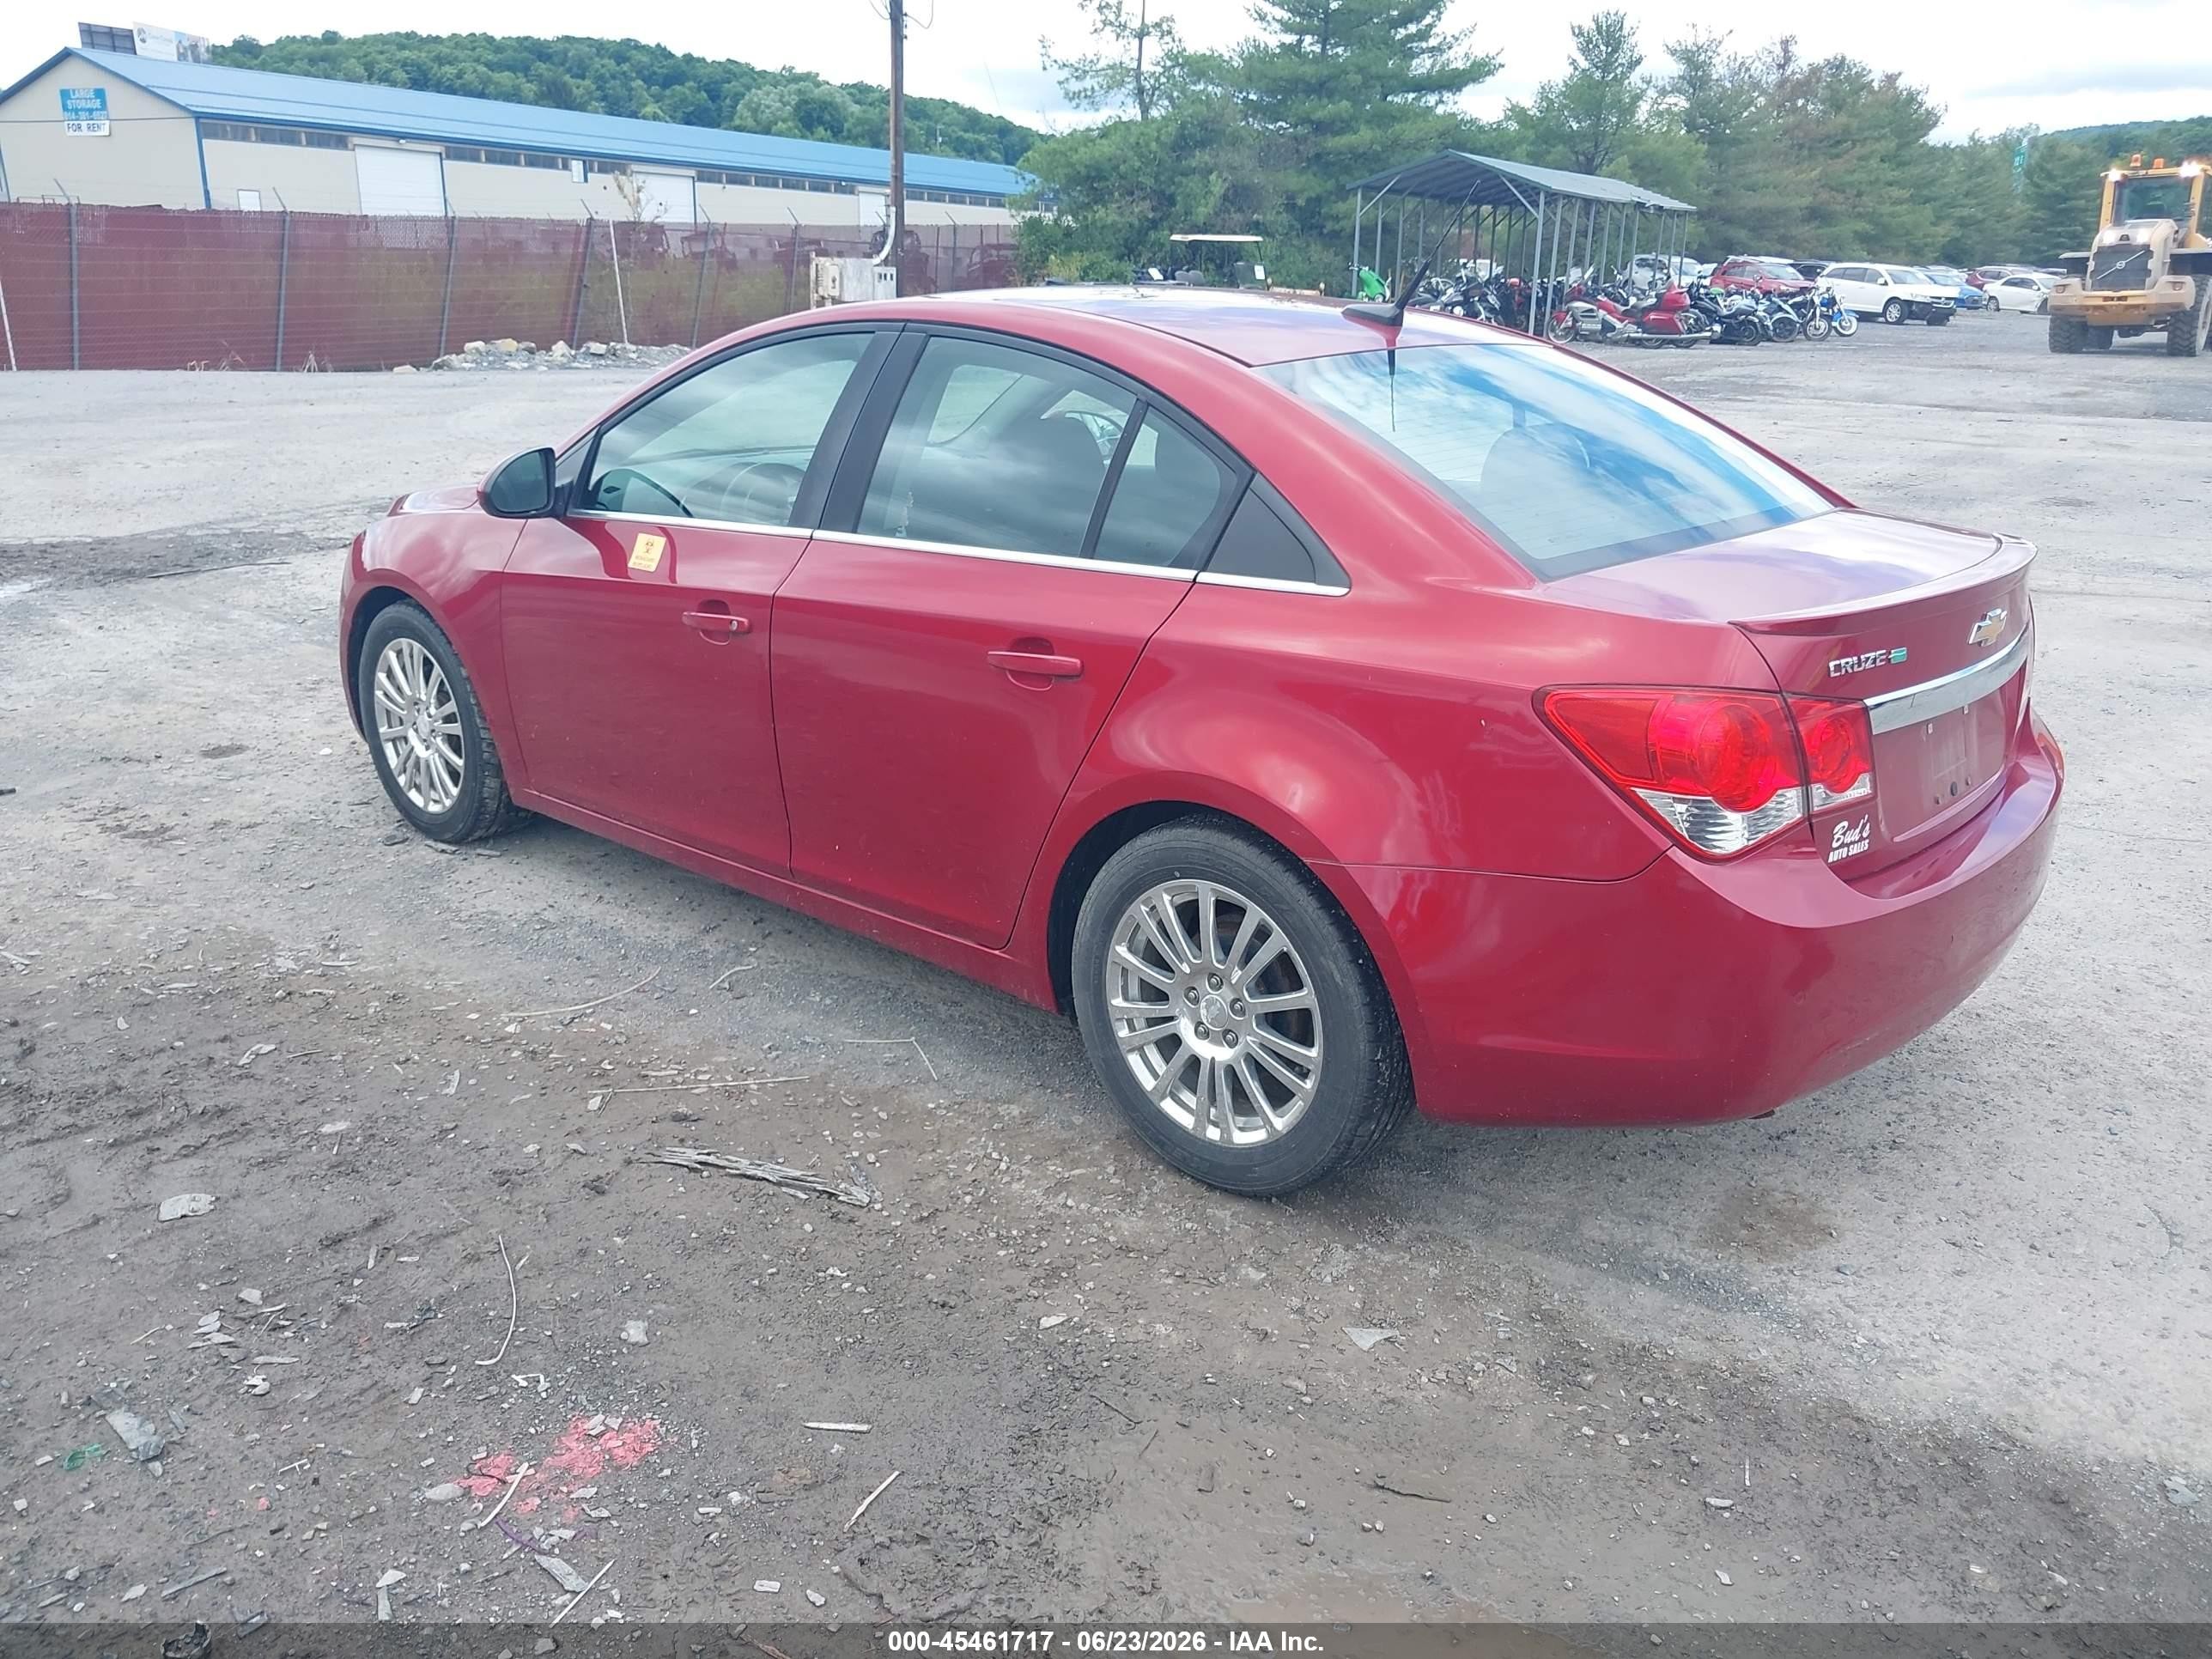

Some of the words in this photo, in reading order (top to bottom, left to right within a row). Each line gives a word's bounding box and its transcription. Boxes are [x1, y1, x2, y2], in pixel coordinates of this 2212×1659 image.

[67, 99, 101, 109] STORAGE
[67, 123, 82, 132] FOR
[87, 123, 106, 132] RENT
[1828, 649, 1887, 678] CRUZE
[1832, 814, 1870, 848] Bud's
[1828, 847, 1848, 863] AUTO
[1848, 839, 1869, 856] SALES
